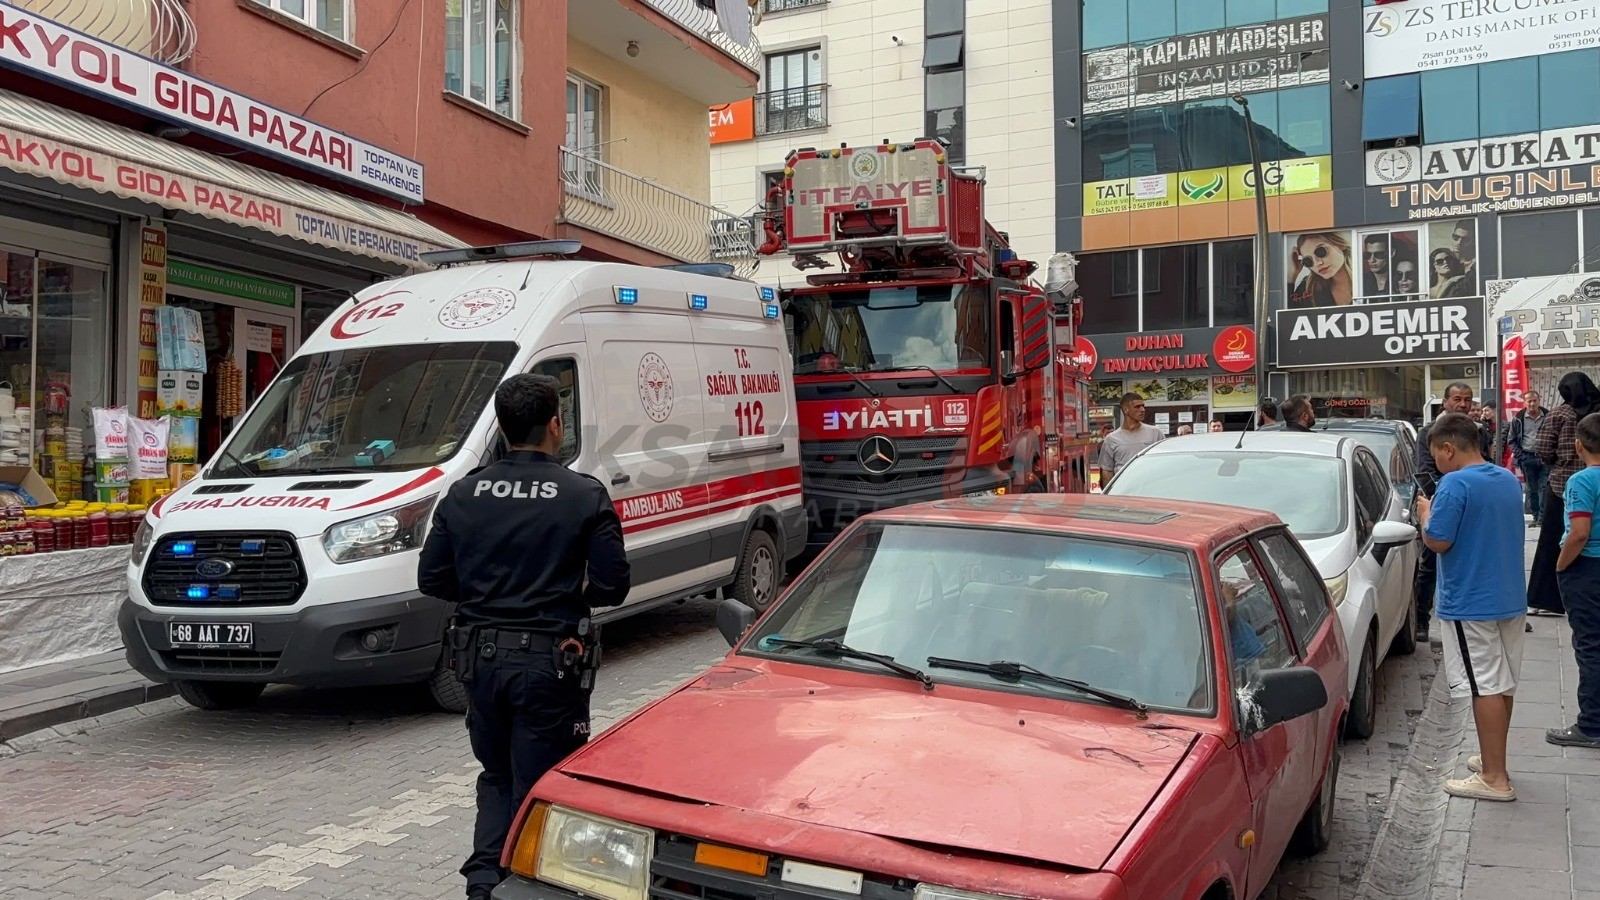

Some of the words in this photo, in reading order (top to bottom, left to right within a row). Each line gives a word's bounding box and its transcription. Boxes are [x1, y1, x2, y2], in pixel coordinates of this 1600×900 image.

[1405, 6, 1434, 27] ZS
[1426, 13, 1559, 42] DANIŞMANLIK
[1143, 36, 1211, 67] KAPLAN
[1215, 20, 1324, 55] KARDEŞLER
[1446, 45, 1483, 56] DURMAZ
[1417, 59, 1439, 68] 0541
[1442, 57, 1459, 65] 372
[1158, 65, 1225, 88] İNŞAAT
[154, 72, 239, 133] GIDA
[248, 106, 354, 172] PAZARI
[364, 150, 404, 174] TOPTAN
[405, 165, 419, 180] VE
[361, 165, 421, 196] PERAKENDE
[800, 179, 933, 206] İTFAİYE
[117, 166, 187, 203] GIDA
[194, 185, 282, 228] PAZARI
[295, 213, 340, 241] TOPTAN
[342, 226, 357, 246] VE
[358, 231, 419, 262] PERAKENDE
[351, 302, 405, 323] 112
[1289, 305, 1469, 341] AKDEMİR
[1125, 333, 1184, 351] DUHAN
[1384, 332, 1471, 355] OPTİK
[734, 348, 751, 369] T.C.
[1101, 353, 1210, 373] TAVUKÇULUK
[706, 370, 739, 396] SAĞLIK
[740, 370, 781, 395] BAKANLIĞI
[735, 400, 764, 436] 112
[946, 403, 965, 414] 112
[473, 480, 559, 499] POLİS
[622, 491, 684, 519] AMBULANS
[178, 625, 192, 642] 68
[198, 625, 221, 642] AAT
[227, 625, 250, 642] 737
